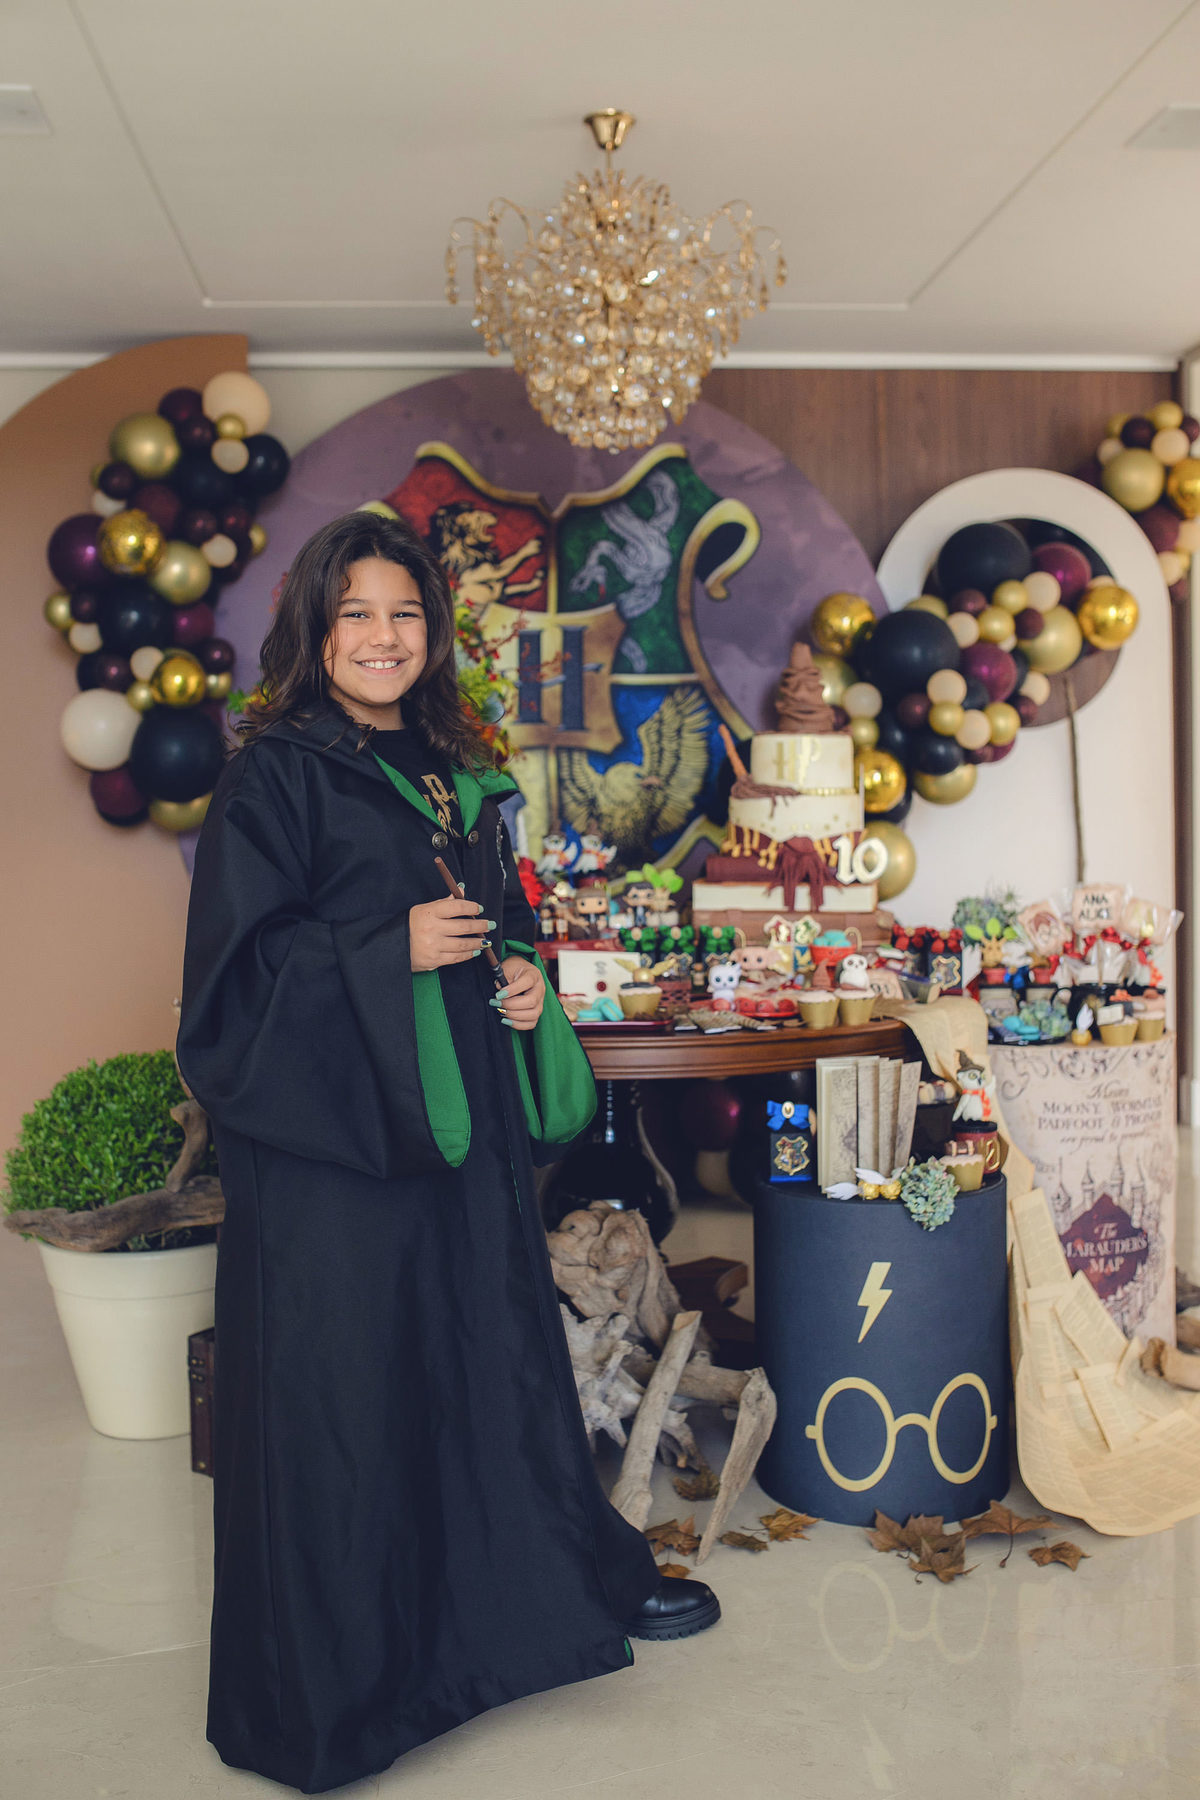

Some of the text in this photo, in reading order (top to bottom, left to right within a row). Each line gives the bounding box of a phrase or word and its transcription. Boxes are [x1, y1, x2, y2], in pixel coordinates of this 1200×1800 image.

[772, 736, 821, 787] HP
[832, 836, 888, 885] 10
[1042, 1101, 1099, 1114] MOONY
[1038, 1116, 1104, 1130] PADFOOT
[1088, 1256, 1124, 1274] MAP
